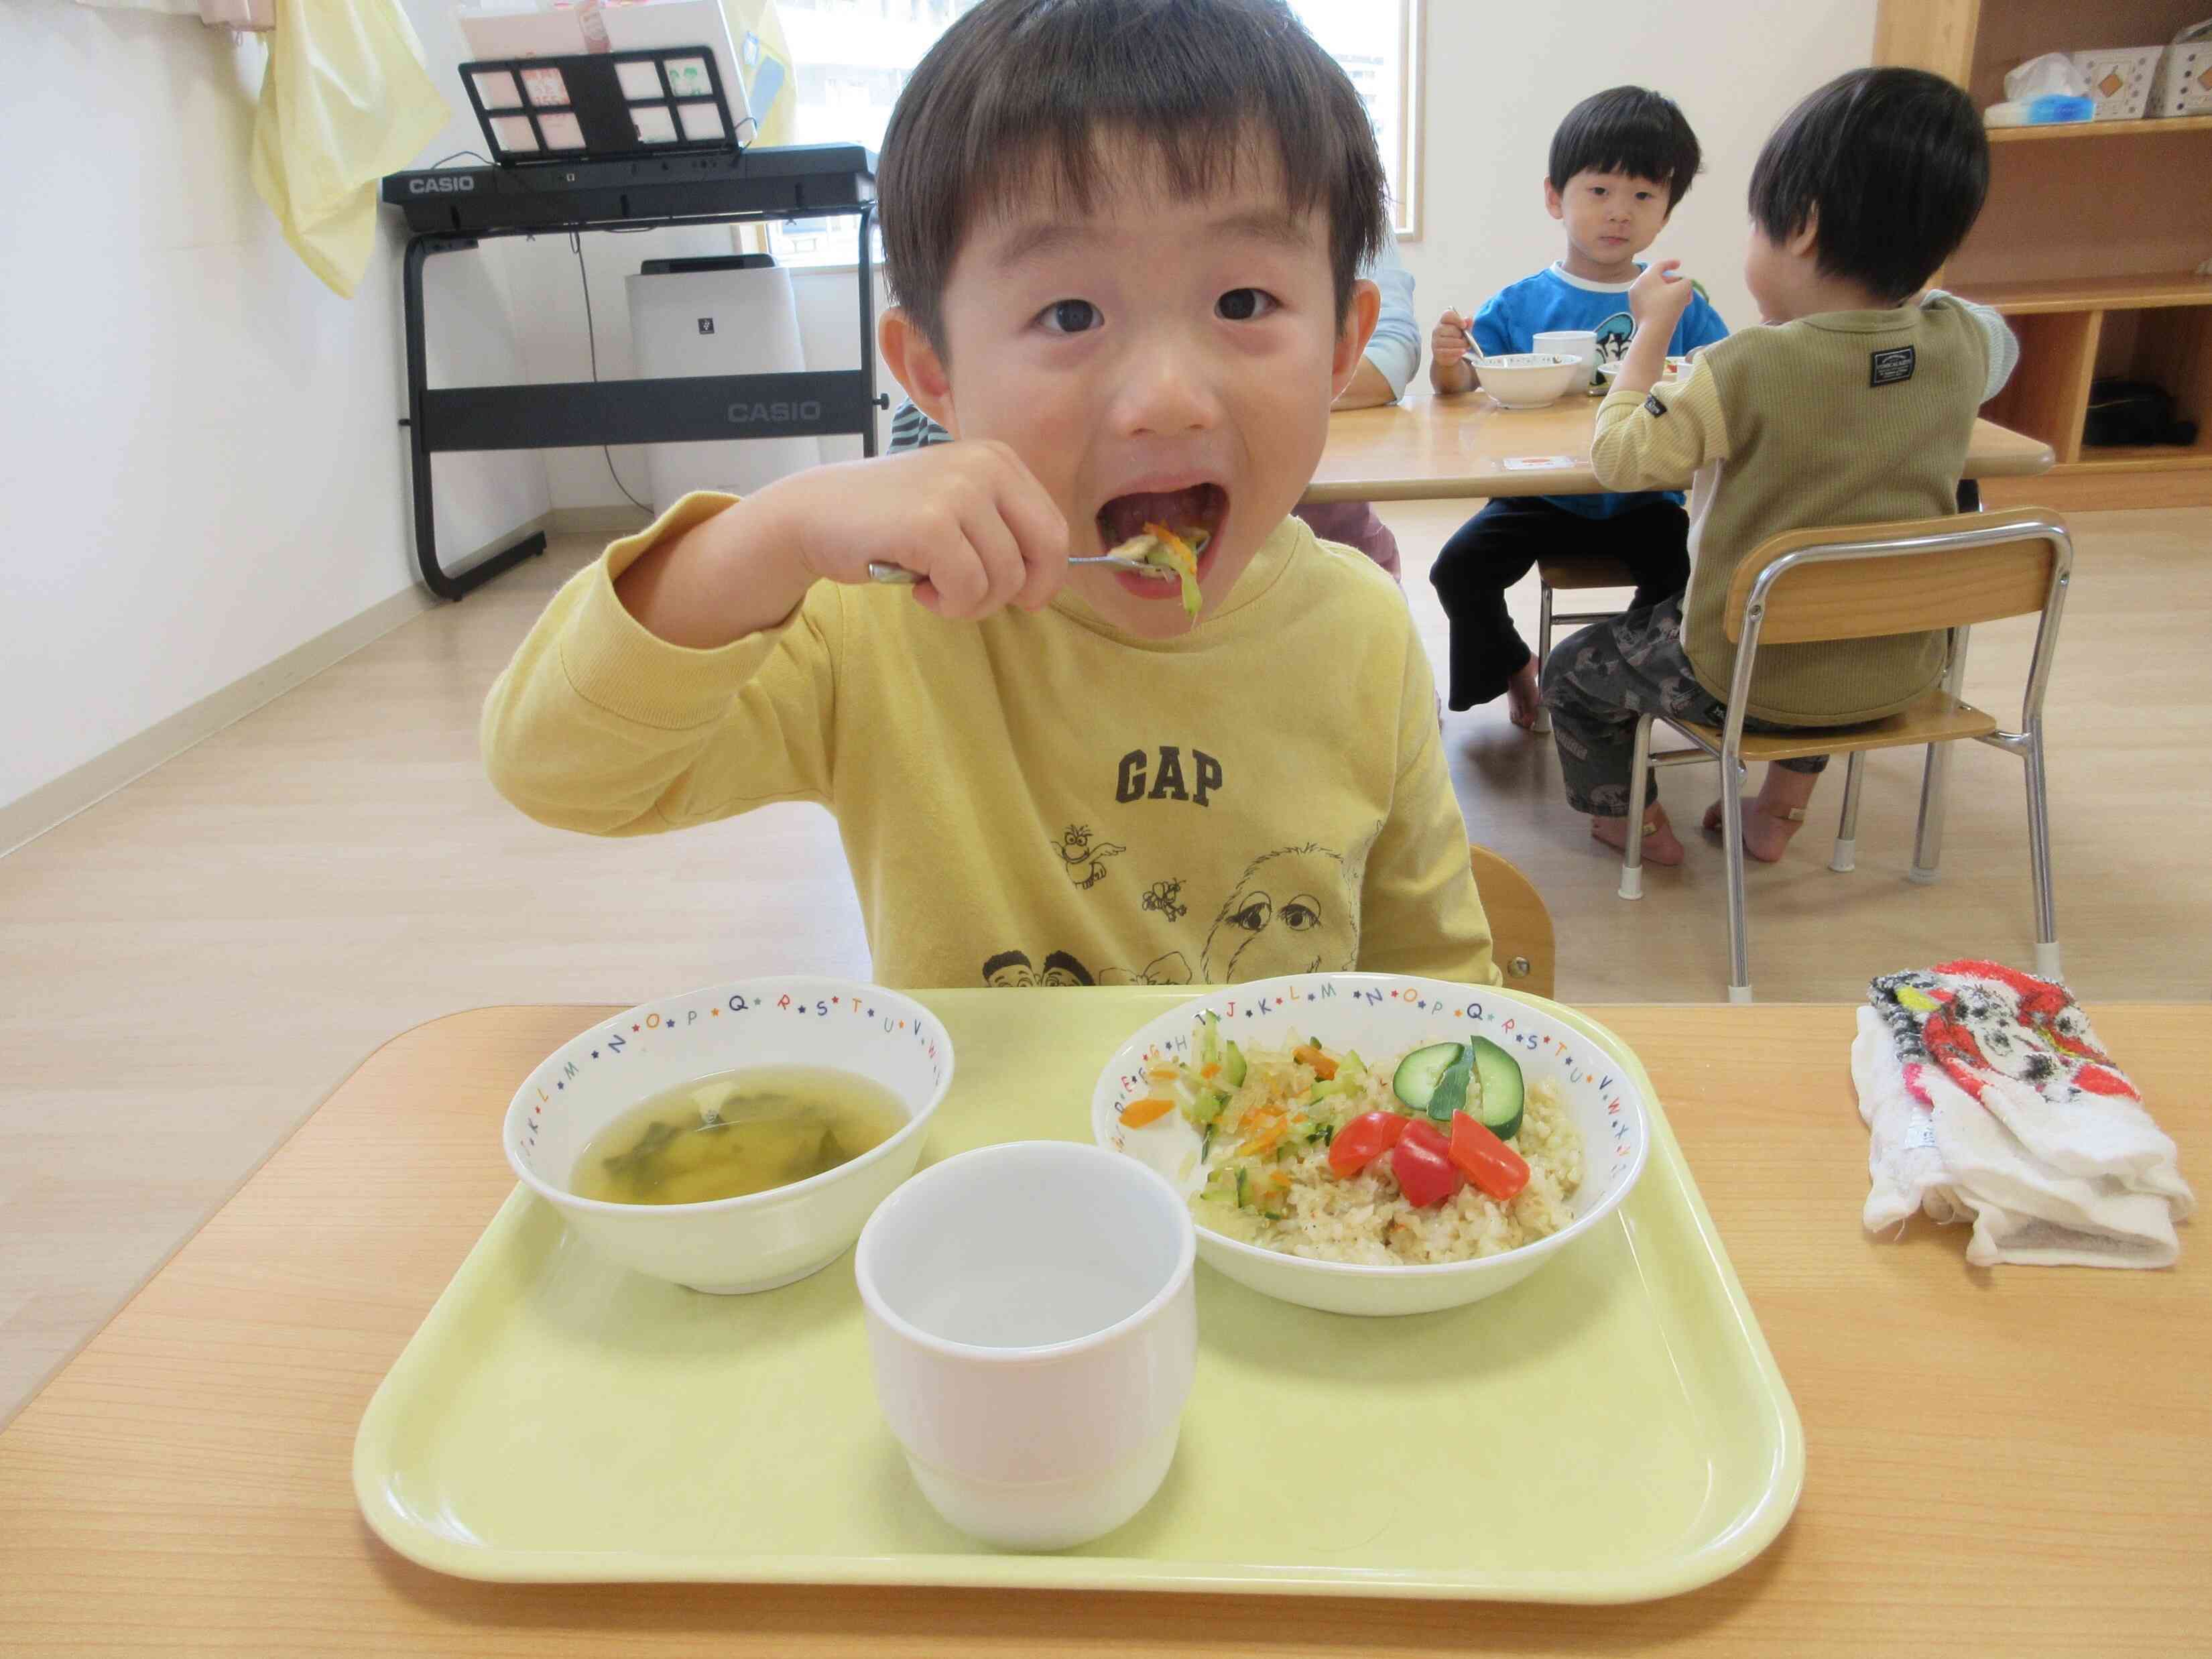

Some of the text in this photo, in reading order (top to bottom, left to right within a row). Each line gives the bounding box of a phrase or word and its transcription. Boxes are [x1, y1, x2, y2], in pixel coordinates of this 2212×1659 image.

[409, 176, 474, 194] CASIO
[727, 400, 821, 423] CASIO
[1115, 745, 1223, 807] GAP
[564, 1061, 579, 1081] M
[608, 1034, 626, 1053] N
[646, 1013, 660, 1028] O
[688, 1010, 697, 1025] P
[729, 995, 749, 1011] Q
[778, 994, 790, 1010] R
[816, 1001, 828, 1016] S
[852, 997, 862, 1013] T
[884, 1017, 894, 1033] U
[914, 1018, 921, 1036] V
[1121, 1075, 1133, 1093] E
[1175, 1034, 1188, 1052] H
[1227, 1001, 1236, 1017] J
[1258, 998, 1272, 1015] K
[1290, 986, 1299, 1000] L
[1320, 982, 1337, 999] M
[1365, 987, 1384, 1006] N
[1404, 988, 1417, 1002] O
[1431, 1001, 1443, 1015] P
[1467, 1003, 1483, 1020] Q
[1501, 1018, 1515, 1034] R
[1526, 1035, 1538, 1050] S
[1554, 1041, 1567, 1056] T
[1570, 1067, 1583, 1083] U
[1599, 1075, 1613, 1091] V
[1608, 1097, 1621, 1115] W
